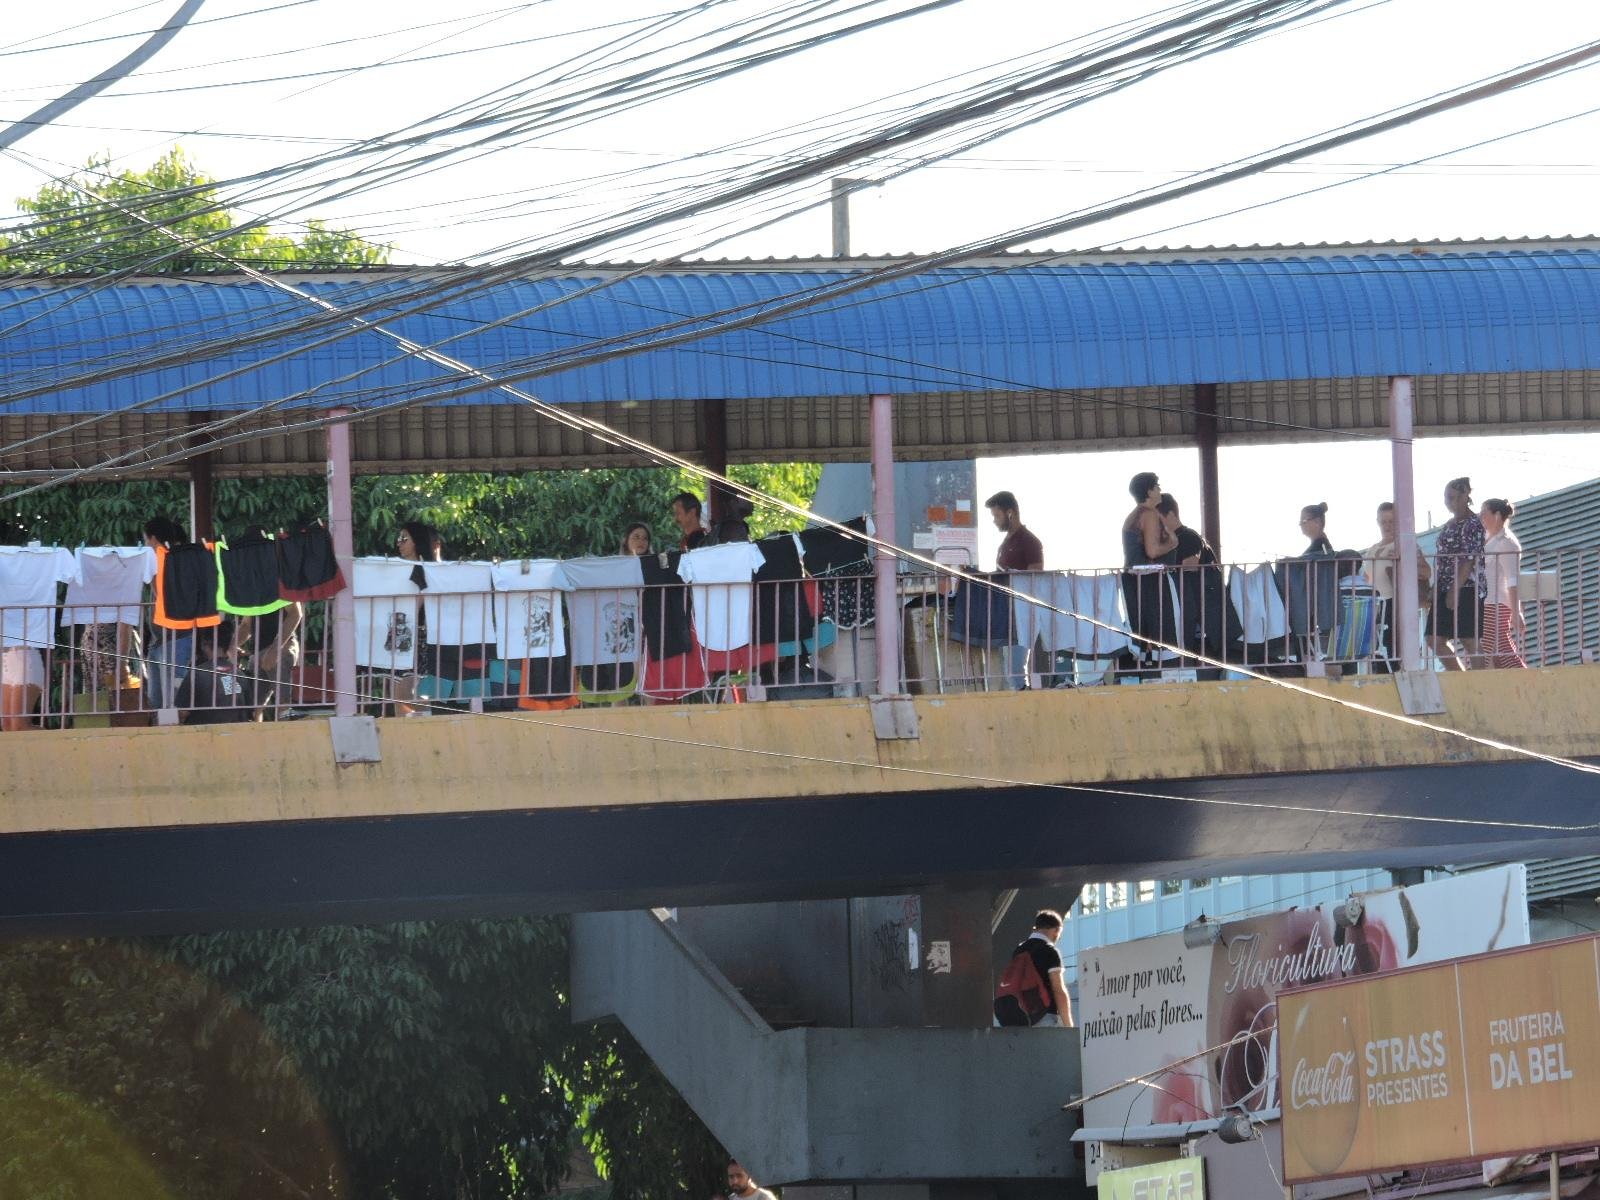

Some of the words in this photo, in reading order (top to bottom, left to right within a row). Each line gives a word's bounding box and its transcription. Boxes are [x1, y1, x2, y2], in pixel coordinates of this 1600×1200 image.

[1096, 970, 1130, 998] Amor
[1132, 969, 1153, 999] por
[1156, 956, 1186, 986] você,
[1224, 921, 1357, 994] Floricultura
[1083, 1010, 1123, 1048] paixão
[1125, 1004, 1156, 1041] pelas
[1157, 999, 1203, 1035] flores...
[1489, 1009, 1566, 1046] FRUTEIRA
[1365, 1030, 1446, 1077] STRASS
[1489, 1050, 1523, 1090] DA
[1527, 1042, 1573, 1085] BEL
[1367, 1072, 1448, 1108] PRESENTES
